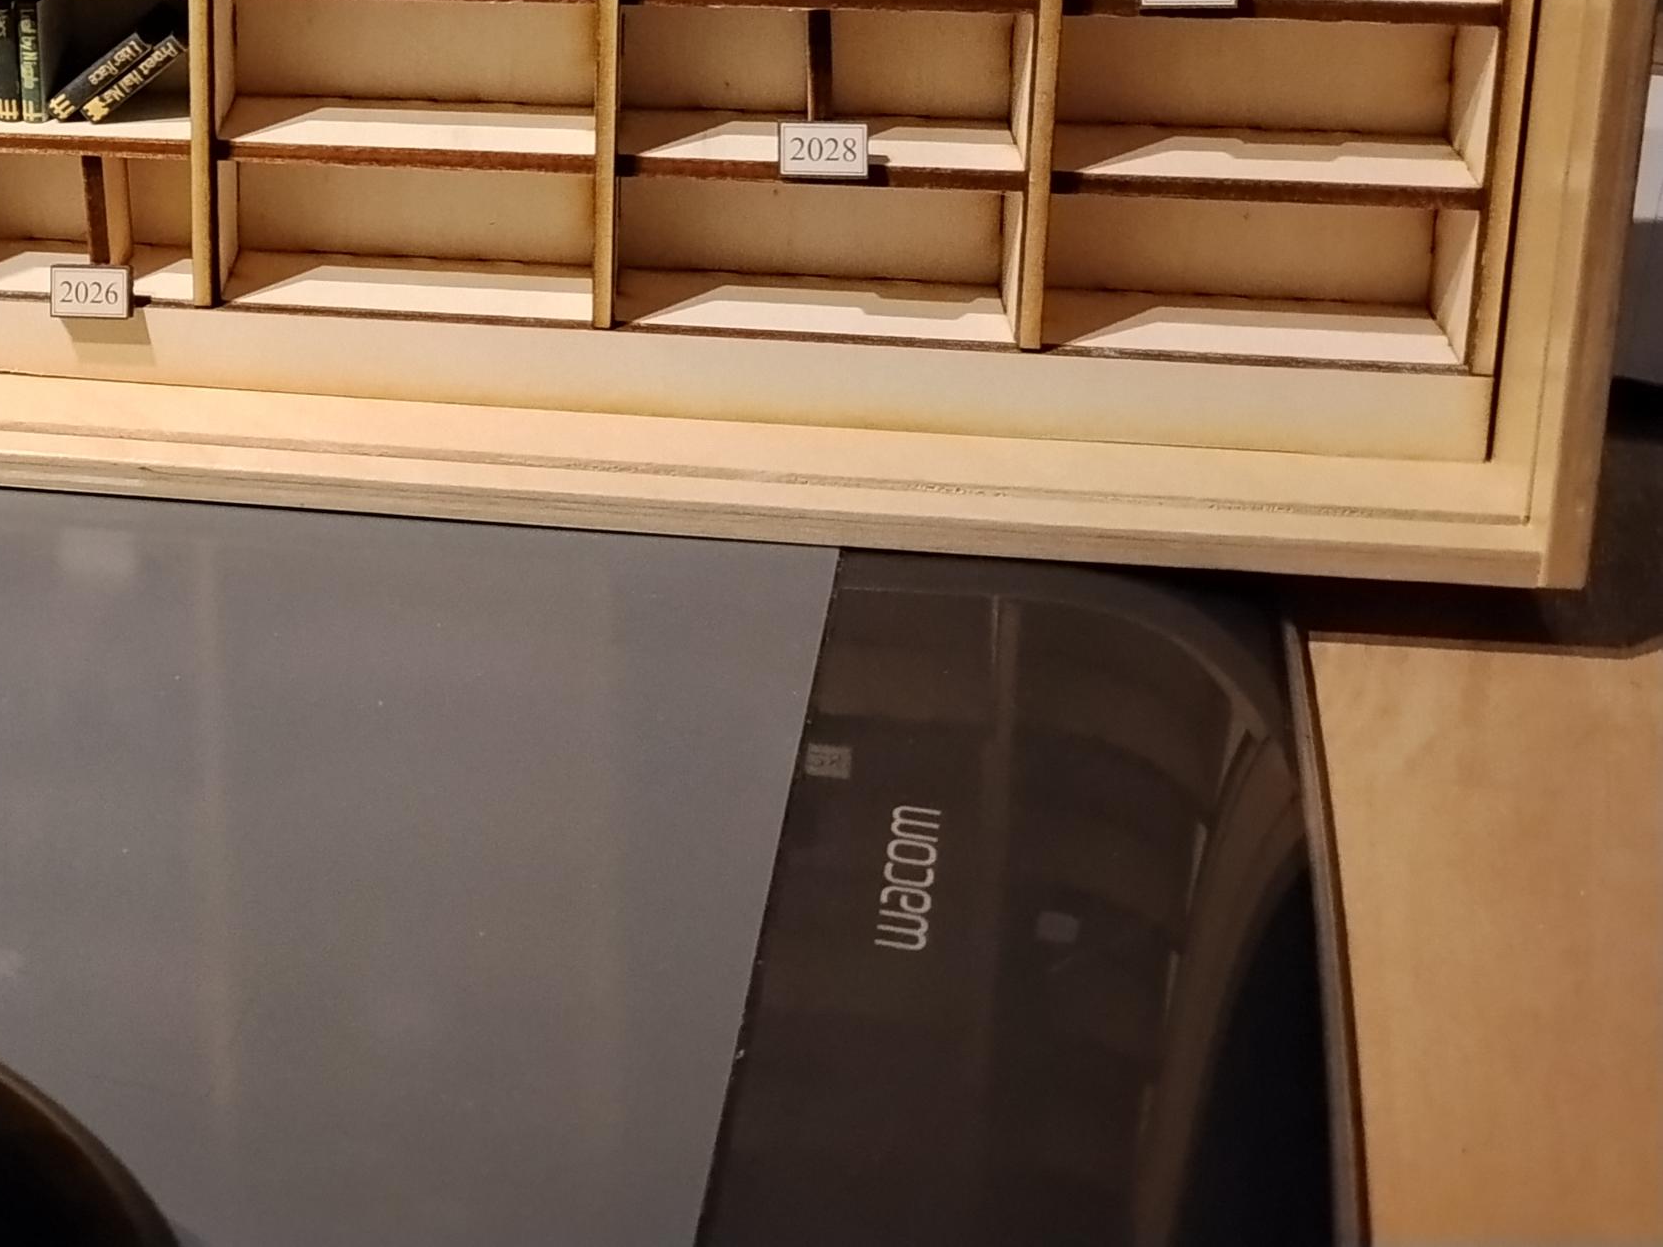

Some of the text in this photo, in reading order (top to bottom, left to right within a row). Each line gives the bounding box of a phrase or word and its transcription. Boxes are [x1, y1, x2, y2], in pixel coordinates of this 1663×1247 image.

[790, 137, 857, 162] 2028
[60, 280, 118, 304] 2026
[874, 805, 942, 952] wacom
